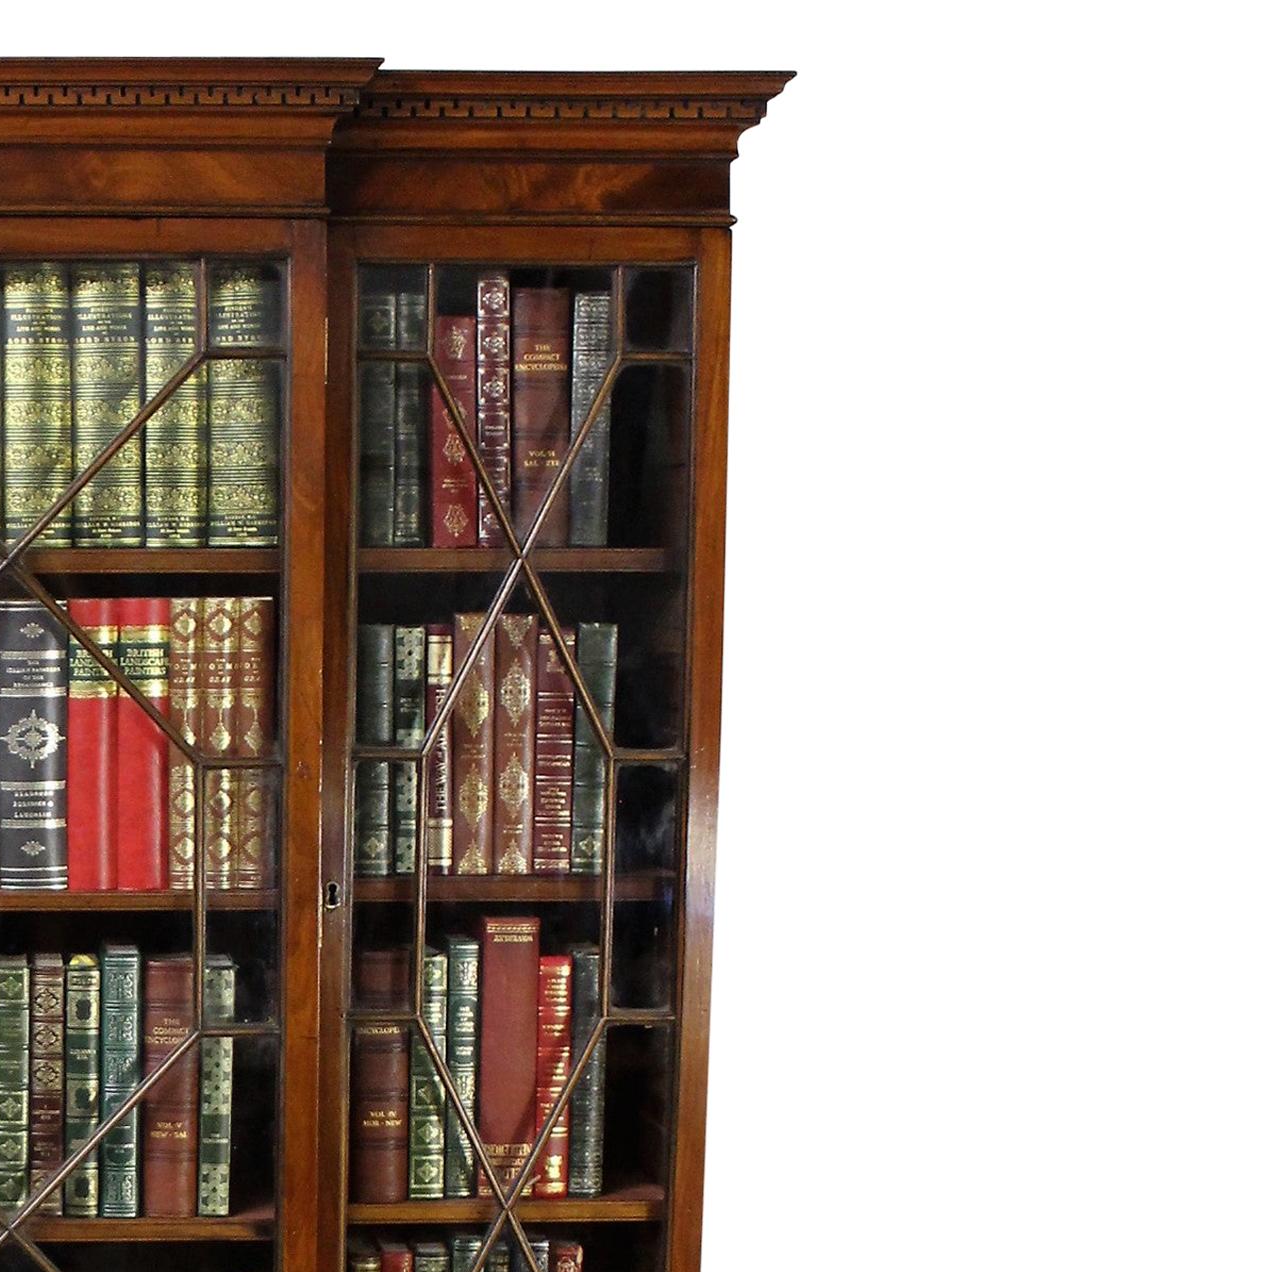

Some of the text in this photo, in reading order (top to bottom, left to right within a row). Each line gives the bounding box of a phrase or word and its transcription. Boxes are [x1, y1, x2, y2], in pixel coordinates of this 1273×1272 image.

[126, 648, 164, 657] BRITISH
[119, 657, 169, 666] LANDSCAPE
[124, 666, 167, 675] PAINTERS
[435, 760, 448, 786] WAY
[435, 785, 448, 812] THE
[164, 1018, 180, 1026] THE
